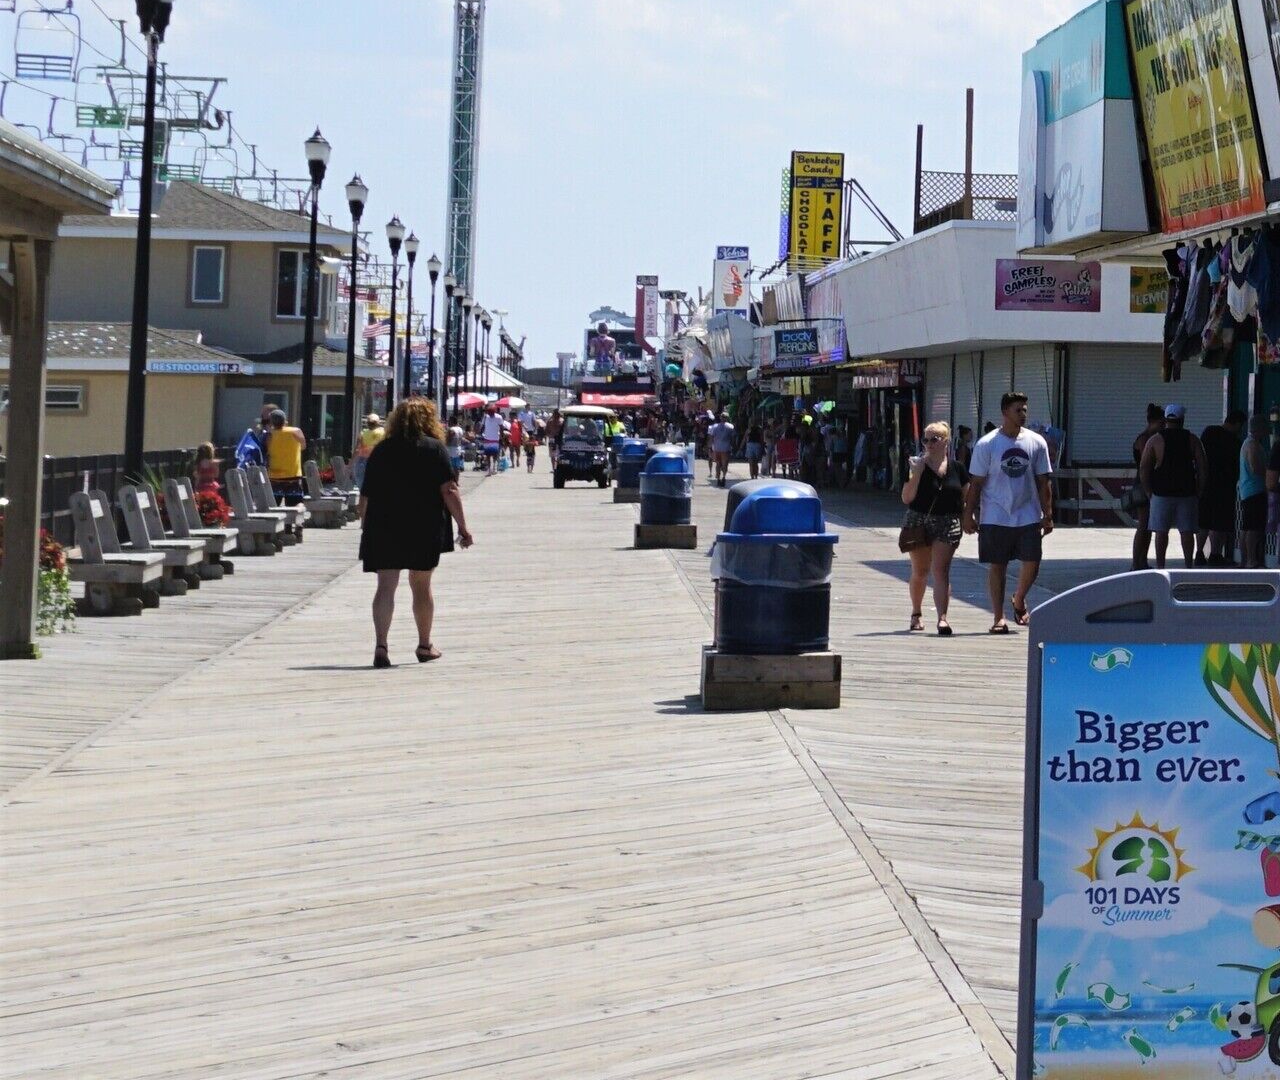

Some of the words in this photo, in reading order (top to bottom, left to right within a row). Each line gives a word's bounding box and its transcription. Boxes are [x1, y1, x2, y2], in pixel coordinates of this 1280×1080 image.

[797, 155, 840, 166] Berkeley
[803, 165, 834, 175] Candy
[1135, 291, 1168, 306] LEMO
[782, 331, 812, 342] body
[152, 362, 217, 372] RESTROOMS
[1075, 710, 1209, 752] Bigger
[1047, 751, 1140, 783] than
[1155, 758, 1246, 783] ever.
[1084, 887, 1117, 905] 101
[1124, 887, 1181, 905] DAYS
[1091, 906, 1106, 915] OF
[1102, 905, 1172, 926] Summer
